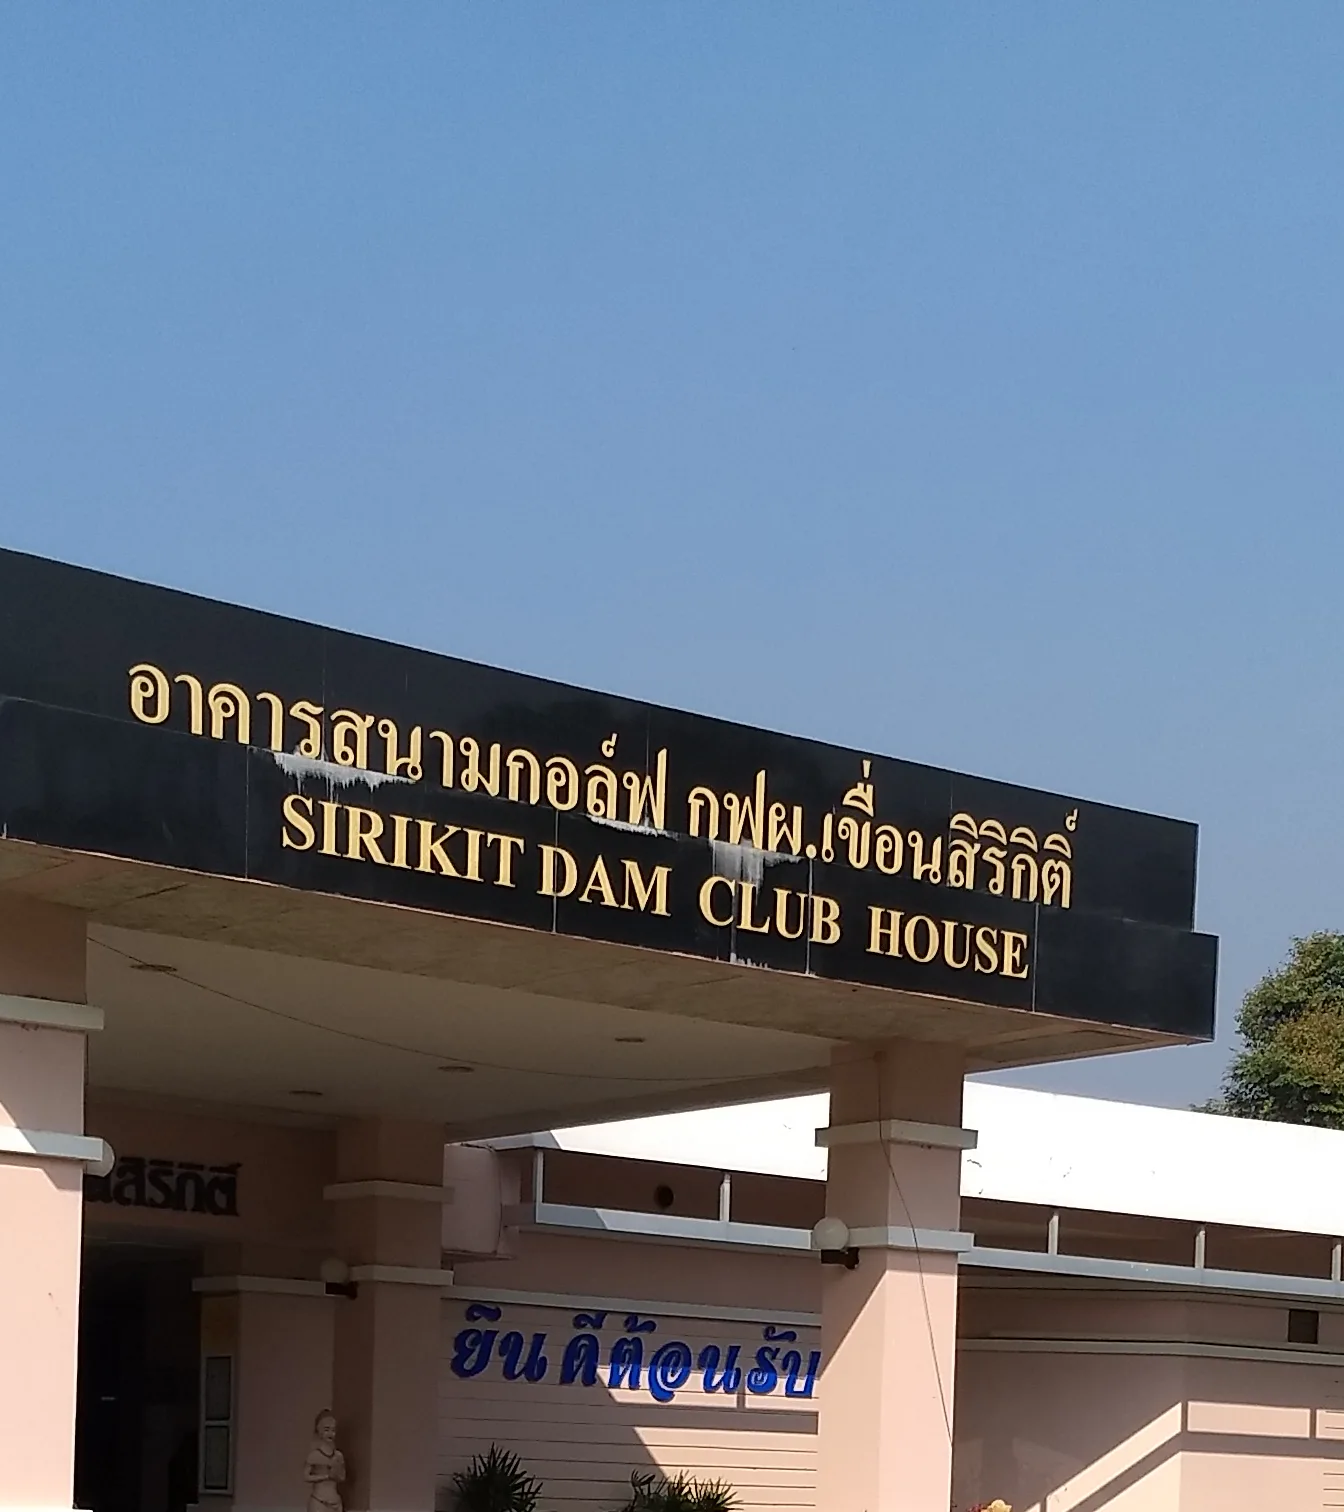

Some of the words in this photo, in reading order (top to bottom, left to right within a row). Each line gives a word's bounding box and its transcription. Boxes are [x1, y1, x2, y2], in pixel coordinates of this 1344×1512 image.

[128, 662, 668, 835] อาคารสนามกอล์ฟ
[282, 793, 525, 888] SIRIKIT
[537, 843, 672, 918] DAM
[698, 875, 841, 945] CLUB
[866, 905, 1029, 980] HOUSE
